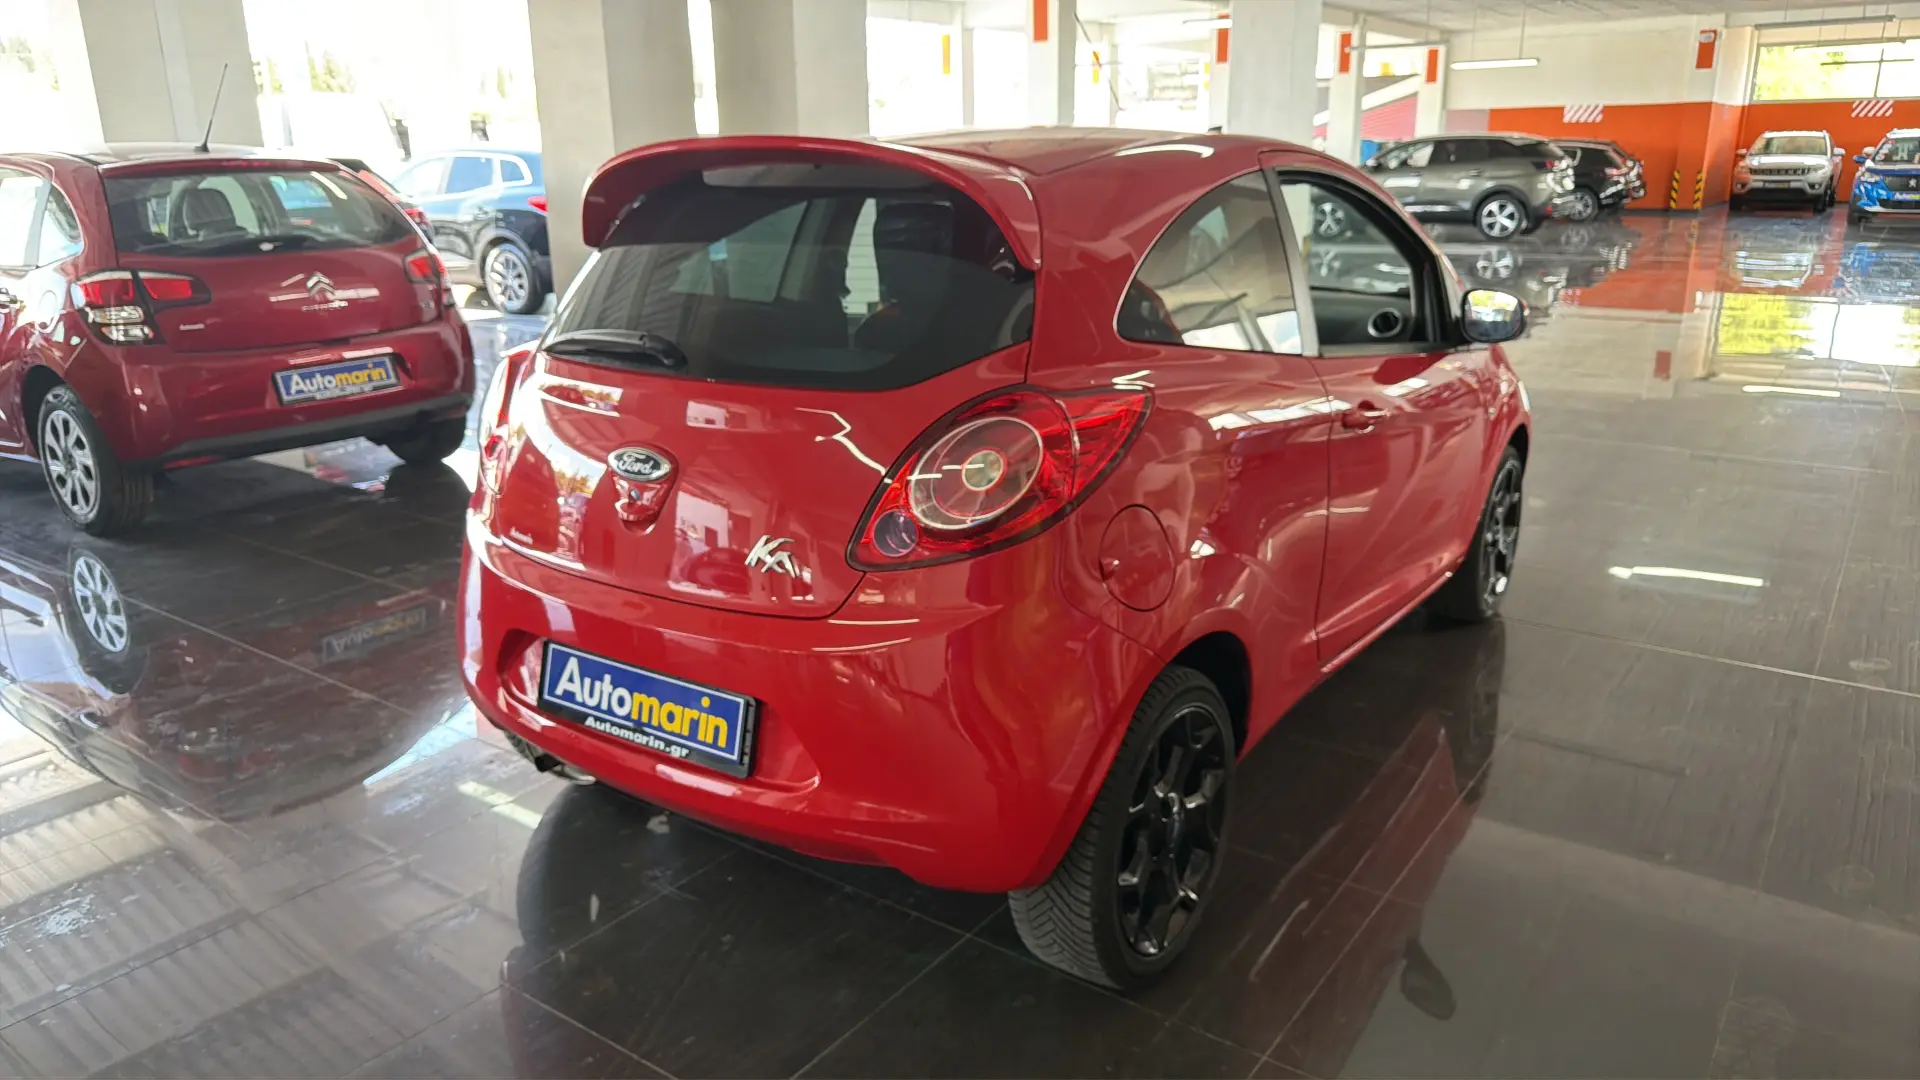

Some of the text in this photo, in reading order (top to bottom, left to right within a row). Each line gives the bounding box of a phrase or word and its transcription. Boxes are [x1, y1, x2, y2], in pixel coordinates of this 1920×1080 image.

[290, 362, 387, 395] Automarin
[618, 451, 655, 475] Ford
[554, 656, 728, 748] Automarin
[584, 716, 690, 759] Automarin.gr
